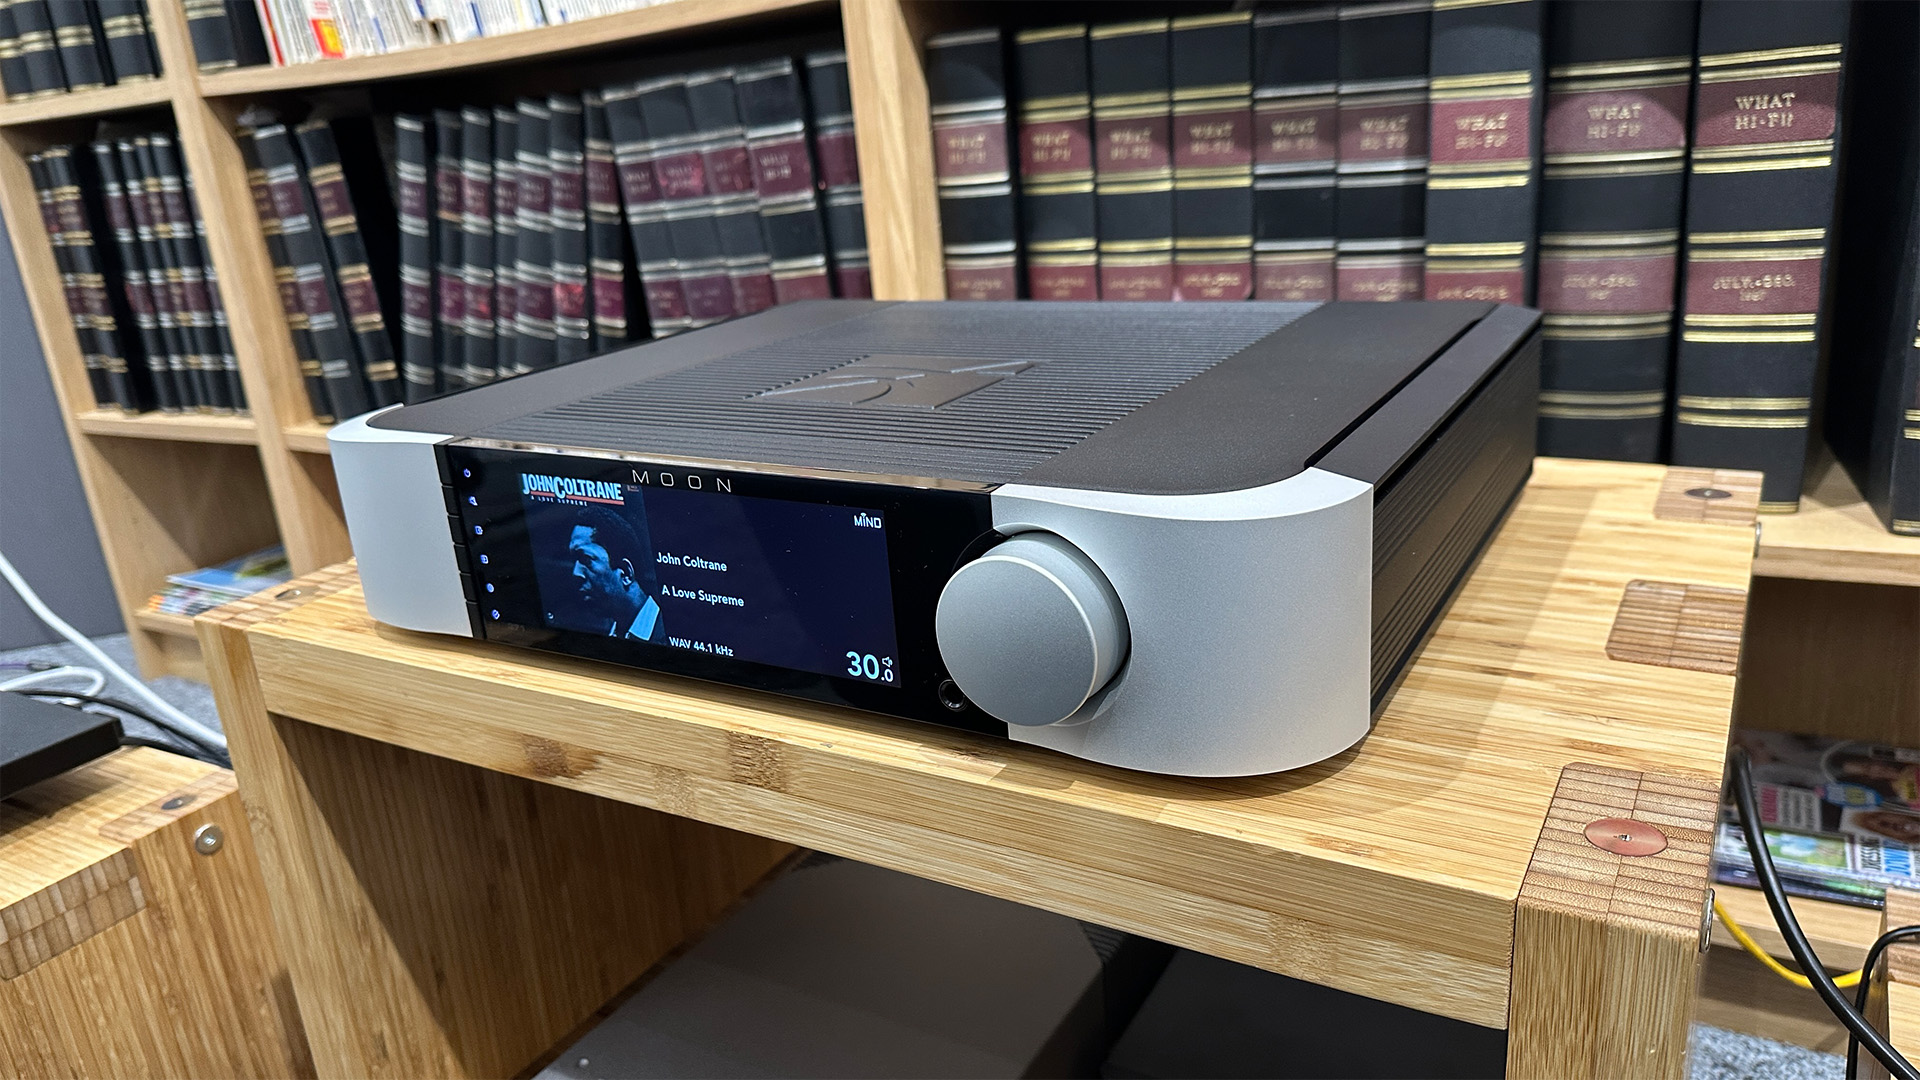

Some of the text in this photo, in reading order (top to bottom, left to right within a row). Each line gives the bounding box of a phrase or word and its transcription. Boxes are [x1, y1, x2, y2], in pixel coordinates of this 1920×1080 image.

[1587, 102, 1642, 120] WHAT
[1735, 92, 1796, 110] WHAT
[632, 469, 732, 493] MOON
[656, 552, 728, 572] John Coltrane
[661, 584, 745, 607] A Love Supreme
[668, 636, 734, 657] WAV 44.1 kHz
